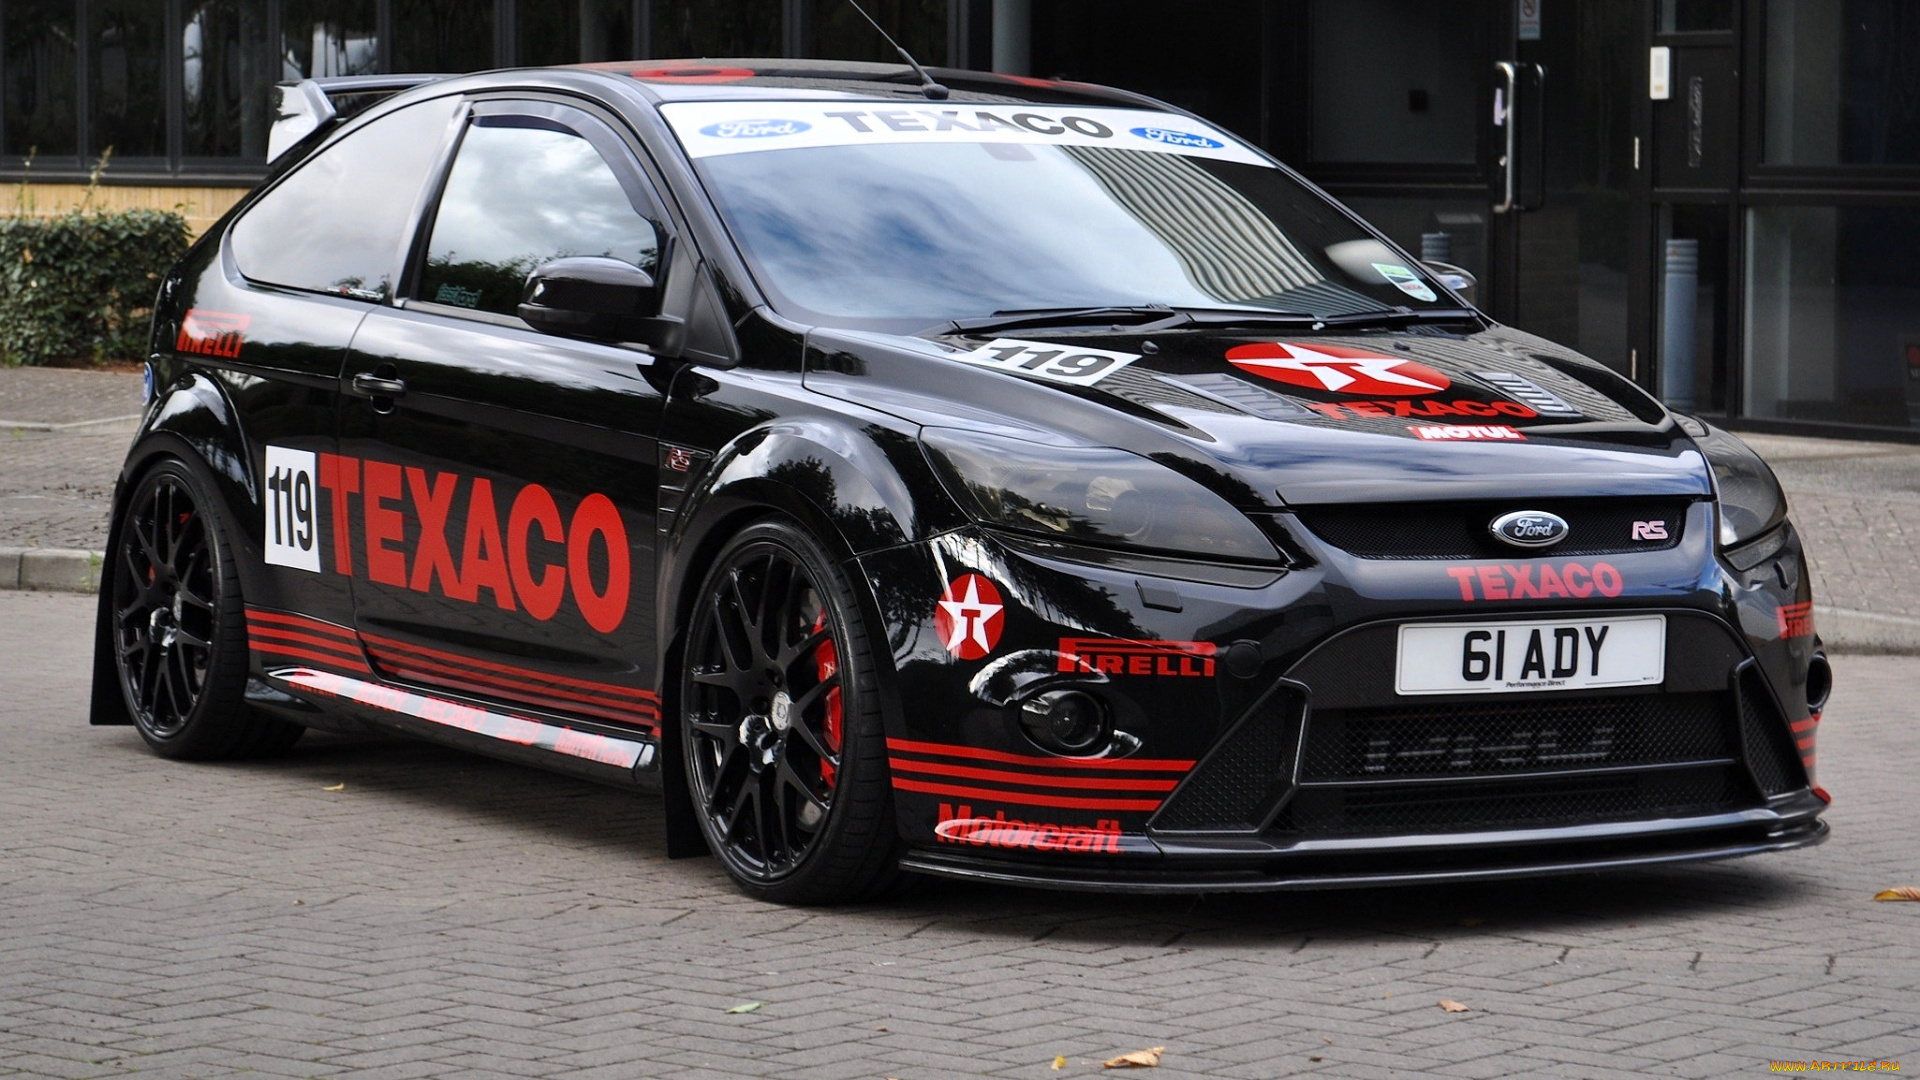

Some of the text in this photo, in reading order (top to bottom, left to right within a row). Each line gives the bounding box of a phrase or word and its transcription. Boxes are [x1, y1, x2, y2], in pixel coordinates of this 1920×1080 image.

[716, 120, 798, 137] Ford
[823, 110, 1114, 139] TEXACO
[1145, 128, 1213, 148] Ford
[176, 309, 251, 358] PIRELLI
[988, 345, 1116, 377] 119
[1306, 400, 1538, 420] TEXACO
[1418, 426, 1520, 439] MOTUL
[1514, 517, 1554, 537] Ford
[1631, 520, 1668, 540] RS
[268, 452, 631, 633] 119 TEXACO
[1447, 562, 1623, 602] TEXACO
[1056, 637, 1218, 677] PIRELLI
[1520, 625, 1610, 680] ADY
[936, 803, 1122, 854] Motorcraft
